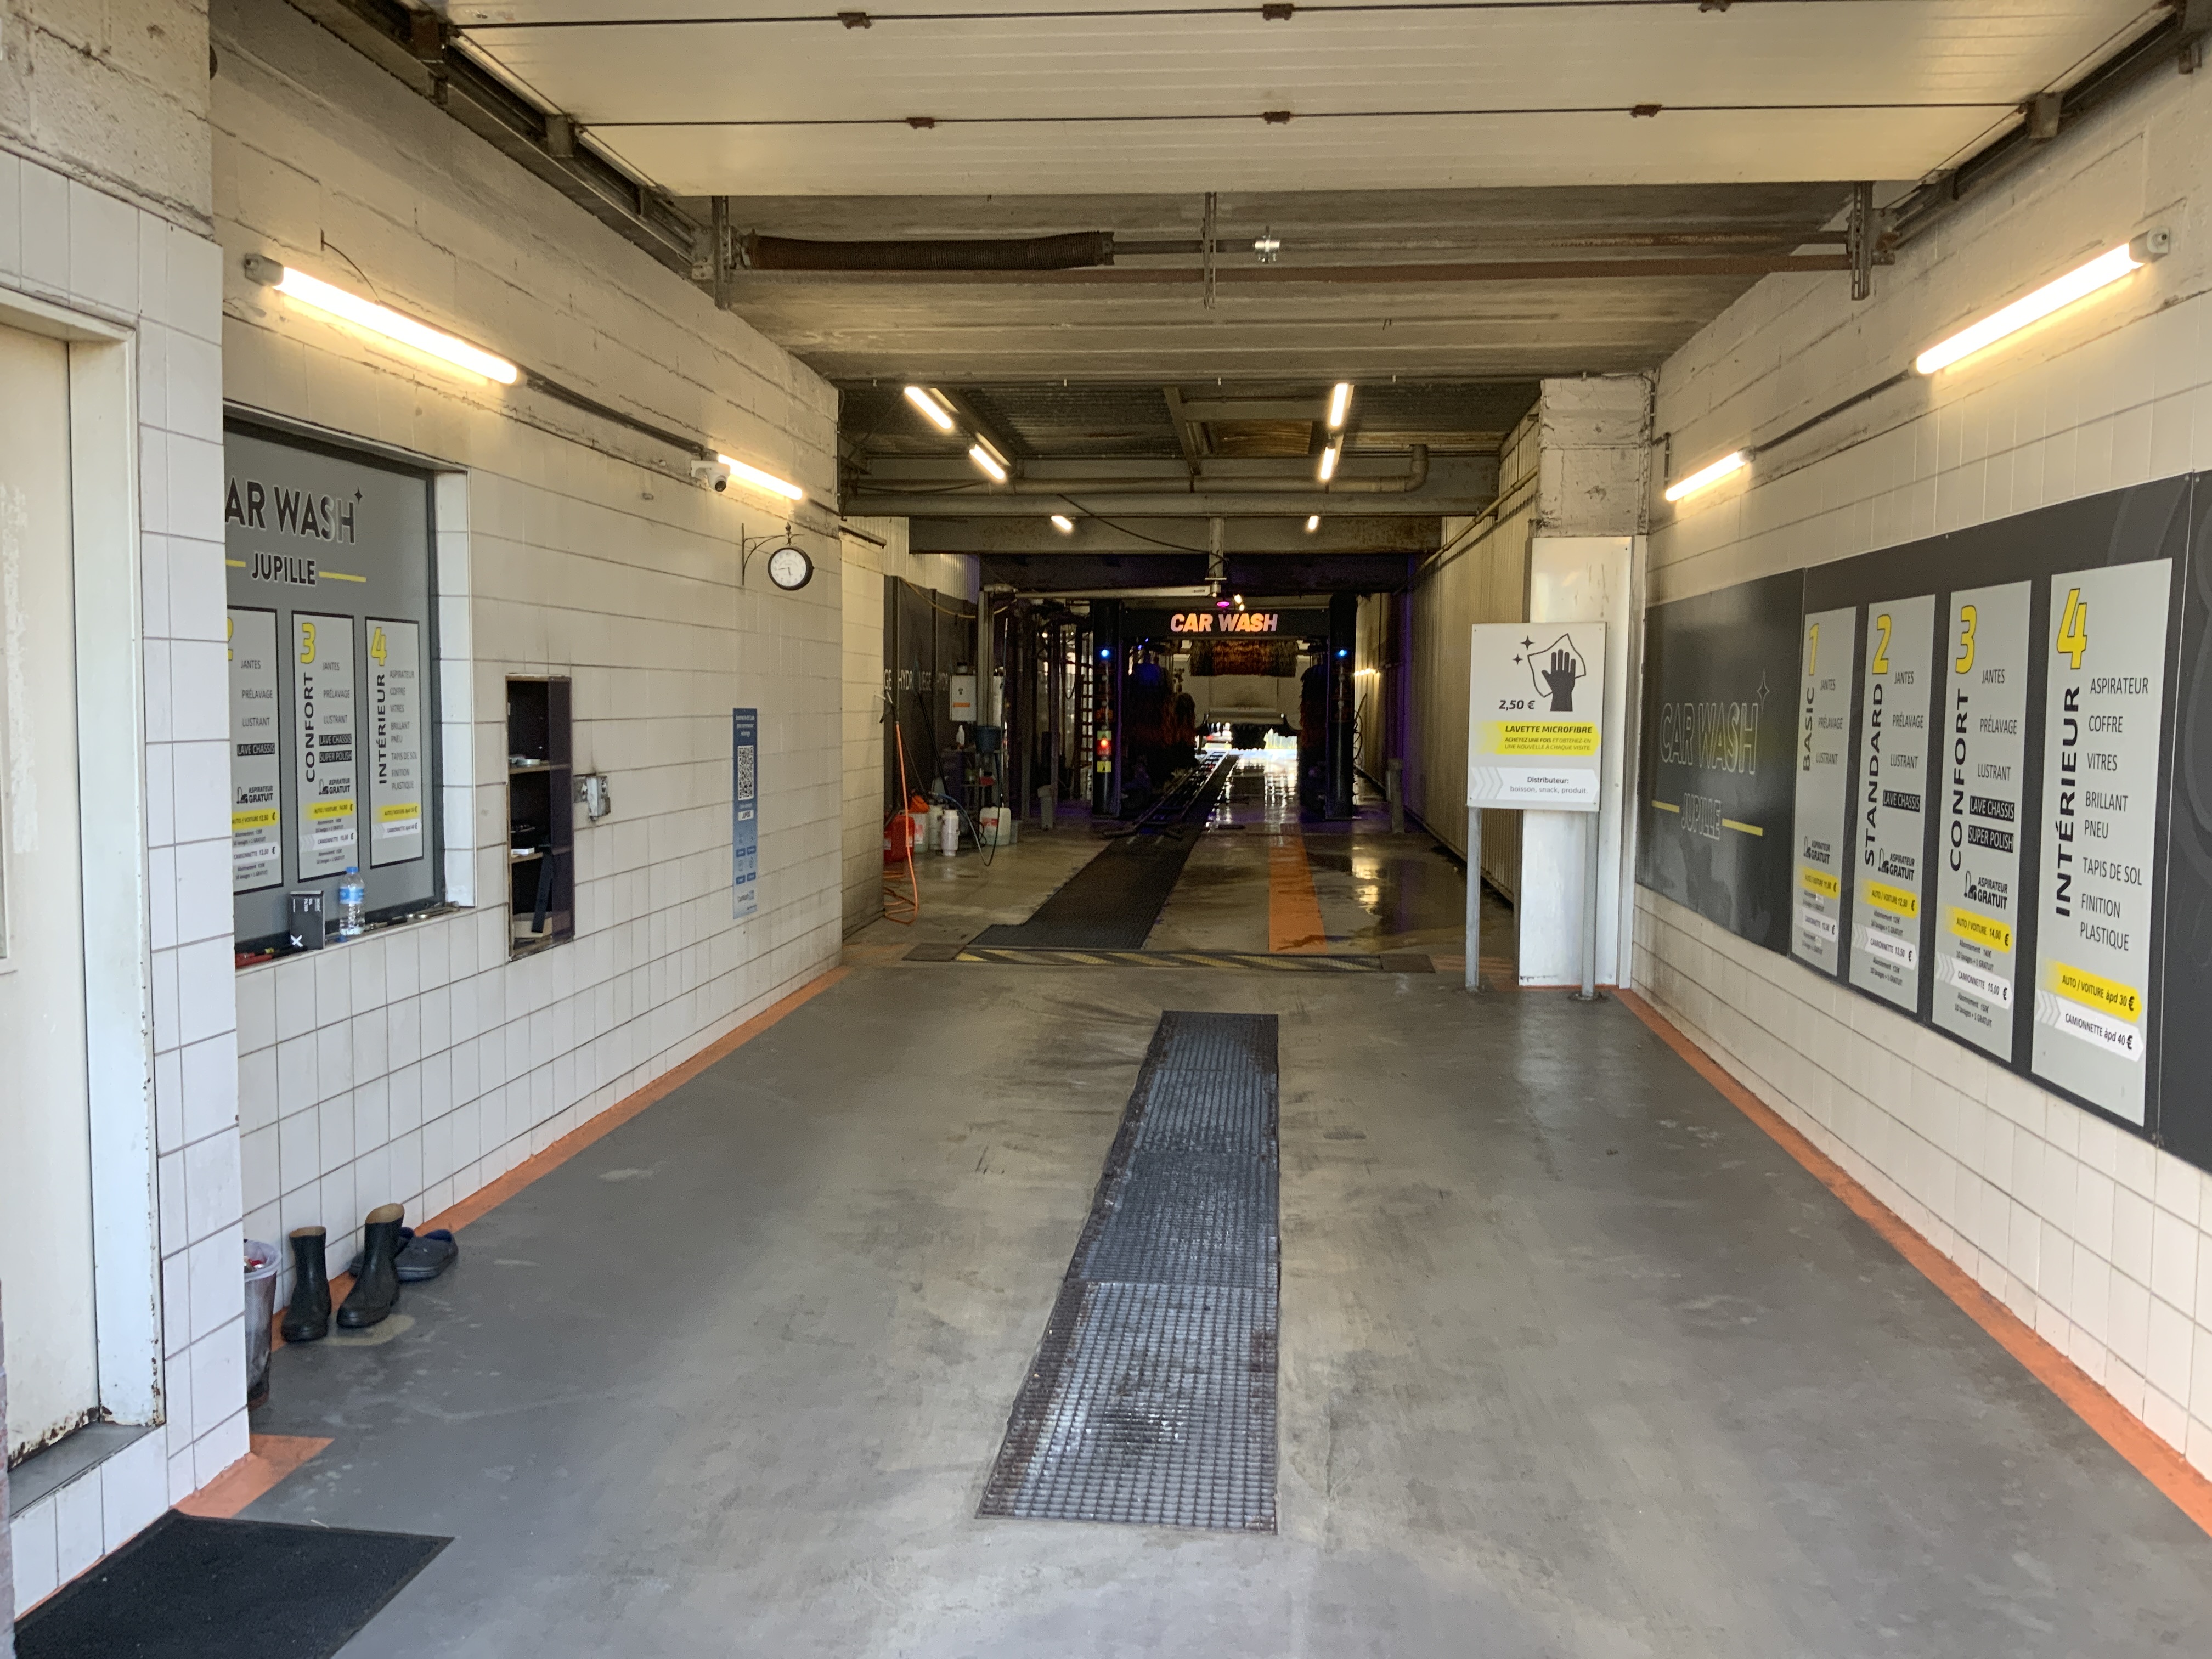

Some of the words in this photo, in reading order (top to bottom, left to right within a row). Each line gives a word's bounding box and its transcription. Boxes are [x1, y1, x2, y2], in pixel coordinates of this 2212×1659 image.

[225, 477, 266, 529] AR
[274, 486, 356, 544] WASH
[251, 552, 316, 585] JUPILLE
[1170, 613, 1213, 632] CAR
[1218, 613, 1278, 632] WASH
[2057, 588, 2087, 669] 4
[300, 622, 316, 664] 3
[371, 627, 387, 666] 4
[1809, 623, 1819, 676] 1
[1872, 614, 1892, 674] 2
[1955, 605, 1977, 674] 3
[241, 660, 261, 669] JANTES
[323, 662, 340, 670] JANTES
[1820, 679, 1836, 691] JANTES
[1894, 671, 1914, 684] JANTES
[1982, 669, 2005, 684] JANTES
[2090, 677, 2148, 695] ASPIRATEUR
[242, 688, 273, 699] PRÉLAVAGE
[323, 689, 350, 698] PRÉLAVAGE
[1499, 699, 1524, 711] 2,50
[1527, 699, 1535, 709] €
[242, 718, 270, 727] LUSTRANT
[304, 672, 315, 782] CONFORT
[324, 715, 347, 724] LUSTRANT
[376, 674, 387, 784] INTÉRIEUR
[1803, 687, 1814, 771] BASIC
[1818, 714, 1843, 730] PRÉLAVAGE
[1893, 712, 1923, 729] PRÉLAVAGE
[1980, 714, 2017, 735] PRÉLAVAGE
[2089, 715, 2123, 733] COFFRE
[320, 736, 332, 744] LAVE
[1660, 702, 1695, 766] CAR
[1699, 702, 1758, 775] WASH
[238, 744, 252, 755] LAVE
[253, 743, 274, 754] CHASSIS
[1890, 754, 1918, 769] LUSTRANT
[2087, 752, 2117, 771] VITRES
[1865, 684, 1882, 867] STANDARD
[1950, 688, 1968, 871] CONFORT
[1978, 763, 2011, 781] LUSTRANT
[249, 793, 273, 803] GRATUIT
[329, 785, 350, 794] GRATUIT
[1883, 792, 1897, 806] LAVE
[1898, 794, 1920, 810] CHASSIS
[1970, 797, 1986, 814] LAVE
[1987, 800, 2014, 819] CHASSIS
[2055, 686, 2080, 917] INTÉRIEUR
[2085, 791, 2129, 812] BRILLANT
[1681, 793, 1721, 840] JUPILLE
[1968, 826, 1989, 845] SUPER
[1990, 830, 2013, 850] POLISH
[2084, 820, 2109, 839] PNEU
[1810, 850, 1830, 864] GRATUIT
[1890, 853, 1915, 867] ASPIRATEUR
[1890, 864, 1915, 881] GRATUIT
[2083, 857, 2107, 878] TAPIS
[2109, 863, 2121, 881] DE
[2124, 867, 2142, 886] SOL
[1978, 877, 2008, 894] ASPIRATEUR
[1978, 889, 2008, 910] GRATUIT
[2081, 893, 2120, 918] FINITION
[1956, 917, 1967, 929] AUTO
[1970, 922, 1987, 935] VOITURE
[2004, 933, 2010, 946] €
[2080, 922, 2129, 952] PLASTIQUE
[1958, 970, 1985, 990] CAMIONNETTE
[2003, 987, 2007, 1000] €
[2062, 975, 2076, 988] AUTO
[2080, 981, 2104, 999] VOITURE
[2106, 990, 2118, 1004] àpd
[2119, 995, 2128, 1007] 30
[2128, 996, 2135, 1011] €
[2065, 1013, 2103, 1037] CAMIONNETTE
[2104, 1028, 2117, 1042] àpd
[2118, 1034, 2126, 1046] 40
[2127, 1035, 2133, 1050] €
